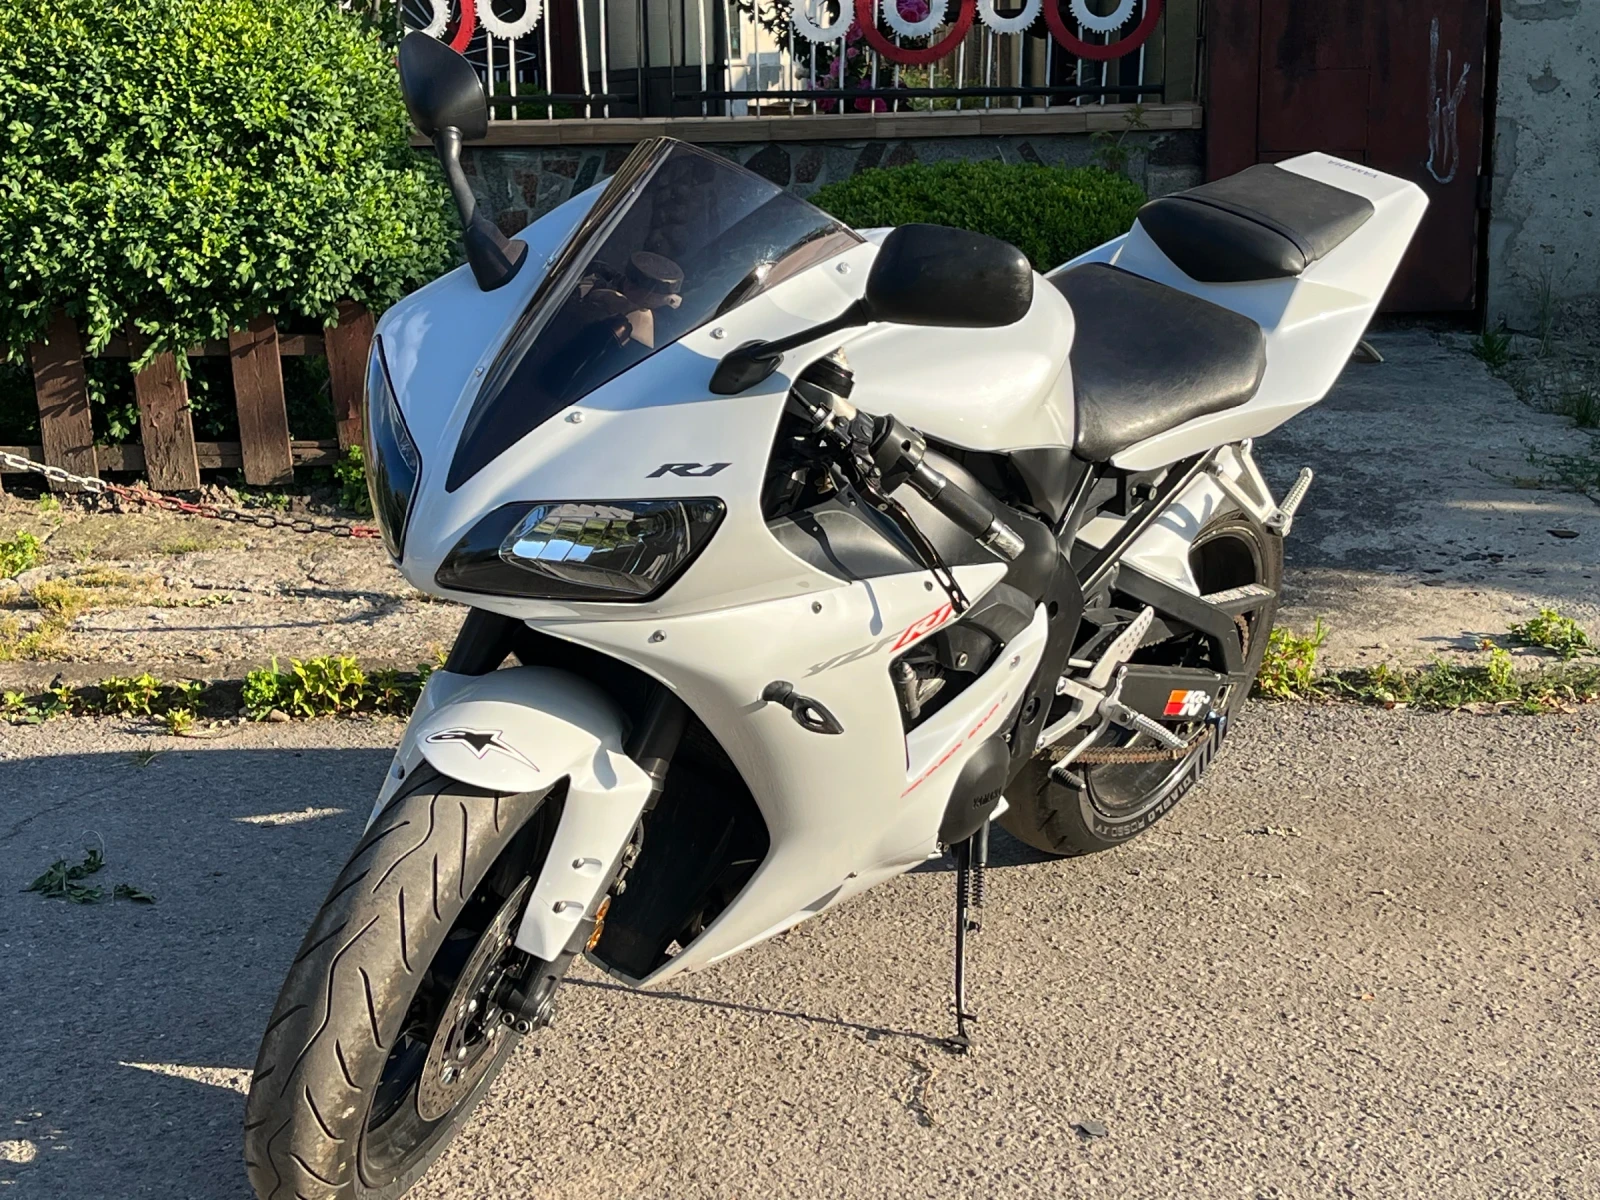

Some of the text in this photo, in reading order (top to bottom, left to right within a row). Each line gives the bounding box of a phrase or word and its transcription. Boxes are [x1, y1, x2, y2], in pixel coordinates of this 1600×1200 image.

[644, 462, 733, 478] R1
[1147, 774, 1194, 823] DIABLO
[1111, 818, 1146, 837] ROSSO
